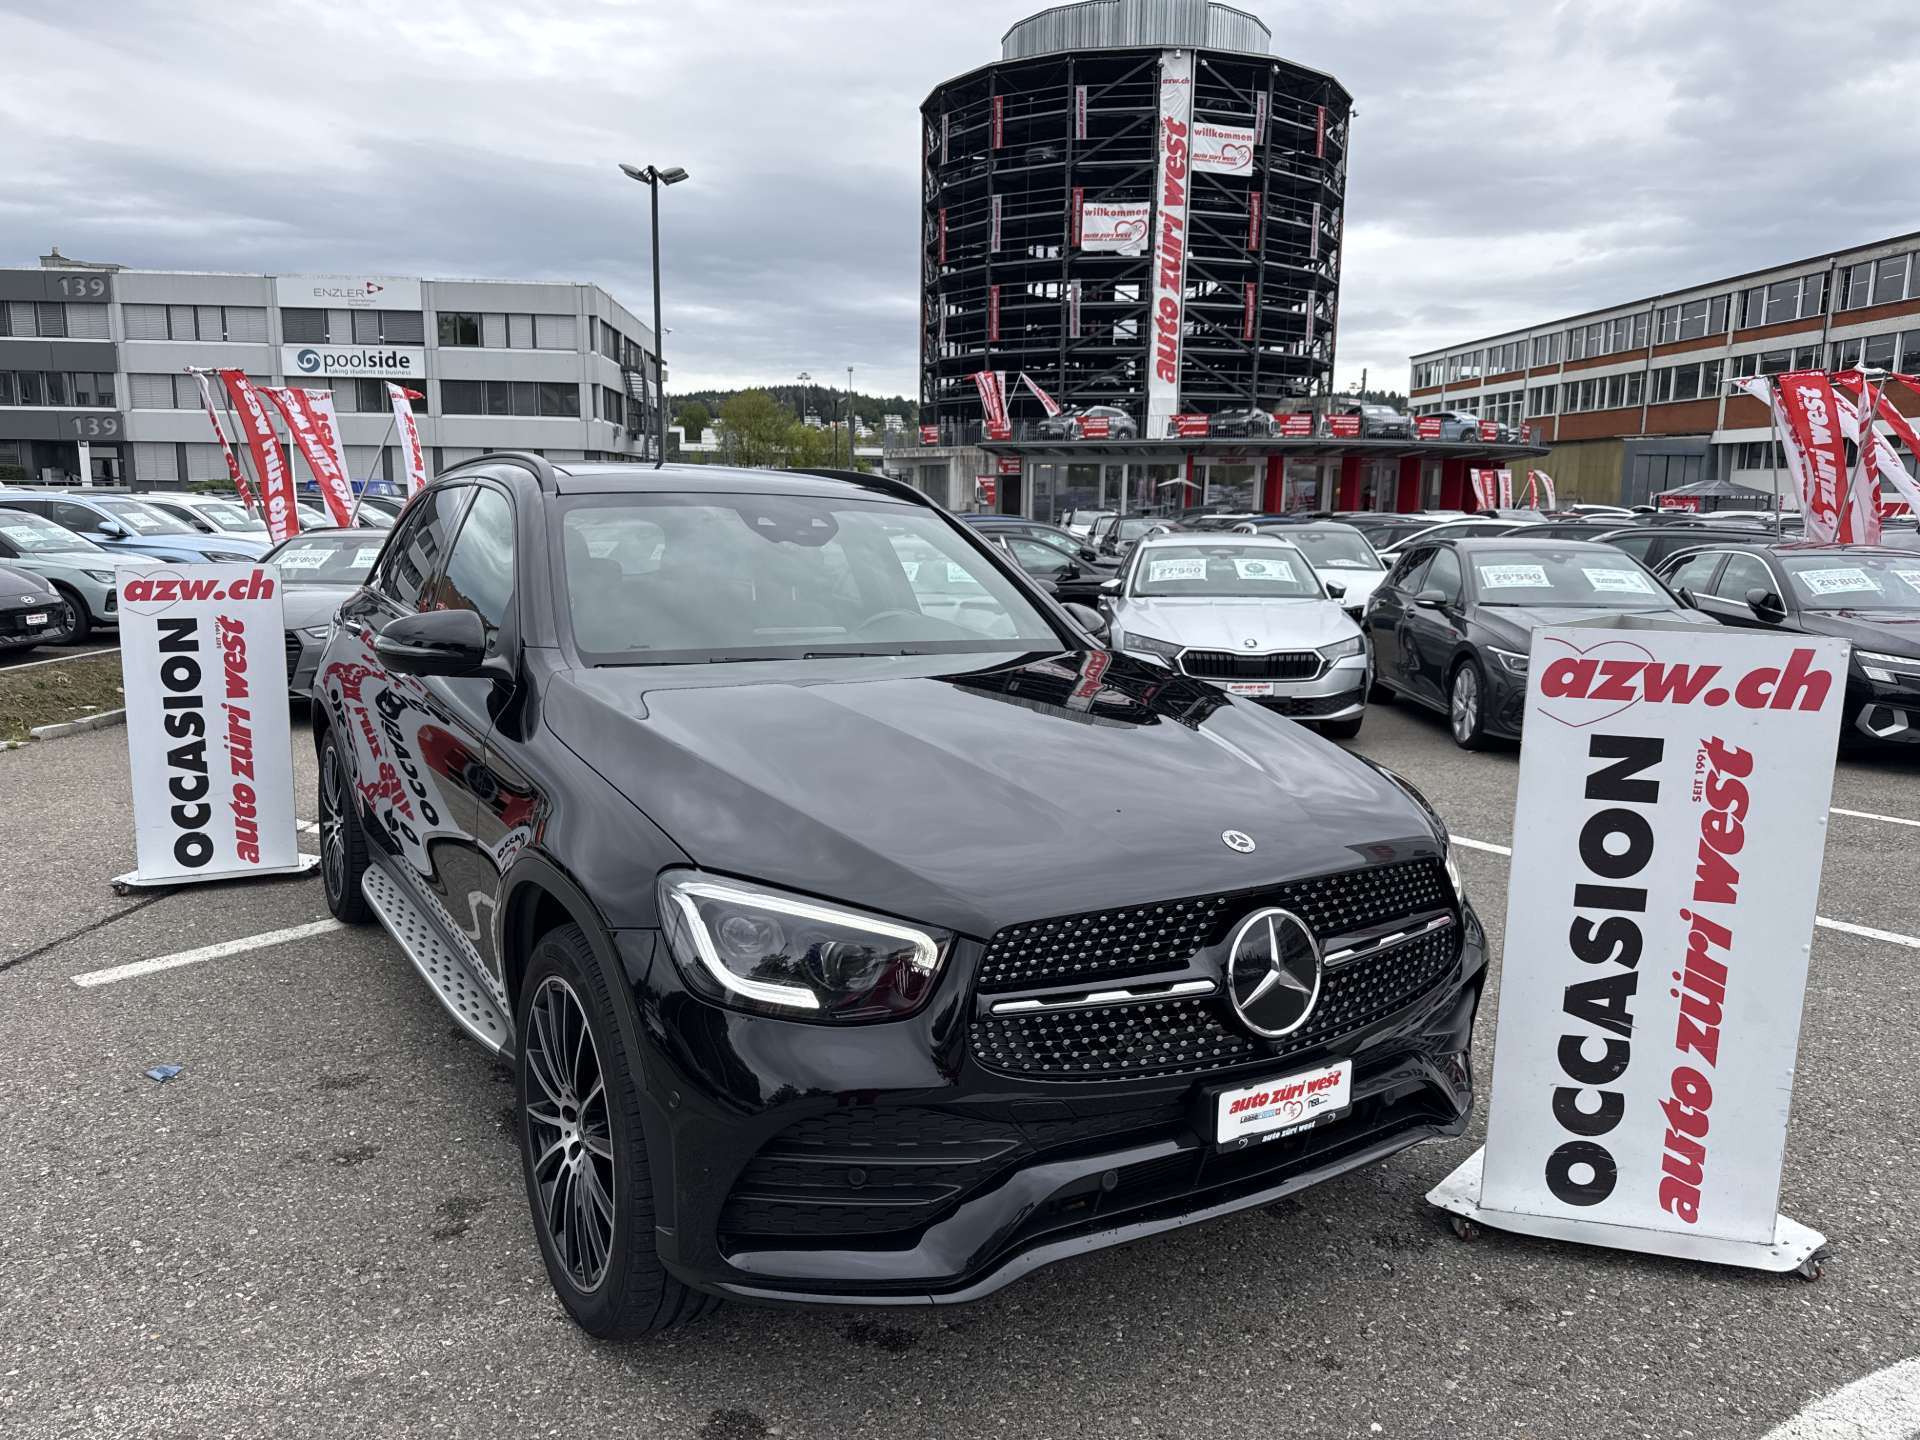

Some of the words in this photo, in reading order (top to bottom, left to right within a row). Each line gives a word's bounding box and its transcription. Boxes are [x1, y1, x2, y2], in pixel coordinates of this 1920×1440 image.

[1163, 116, 1188, 206] west
[1193, 127, 1252, 141] willkommen
[1084, 207, 1148, 217] willkommen
[1156, 210, 1183, 296] züri
[58, 276, 105, 297] 139
[313, 287, 365, 298] ENZLER
[323, 350, 411, 374] poolside
[1155, 297, 1178, 384] auto
[71, 416, 118, 436] 139
[276, 389, 311, 430] wes
[1799, 385, 1834, 445] west
[299, 429, 338, 477] züri
[403, 411, 424, 472] west
[1809, 447, 1837, 508] züri
[124, 569, 275, 602] azw.ch
[1816, 576, 1866, 587] 26'800
[215, 614, 249, 699] west
[1540, 648, 1833, 712] azw.ch
[157, 617, 214, 869] OCCASION
[221, 702, 255, 782] züri
[1695, 747, 1708, 774] 1991
[1692, 775, 1703, 803] SEIT
[229, 782, 260, 864] auto
[1692, 736, 1756, 905] west
[1545, 733, 1665, 1207] OCCASION
[1671, 907, 1733, 1069] züri
[1229, 1091, 1270, 1115] auto
[1269, 1079, 1306, 1105] züri
[1307, 1070, 1342, 1094] west
[1262, 1131, 1280, 1143] auto
[1281, 1125, 1298, 1138] züri
[1299, 1120, 1316, 1133] west
[1657, 1066, 1713, 1225] auto
